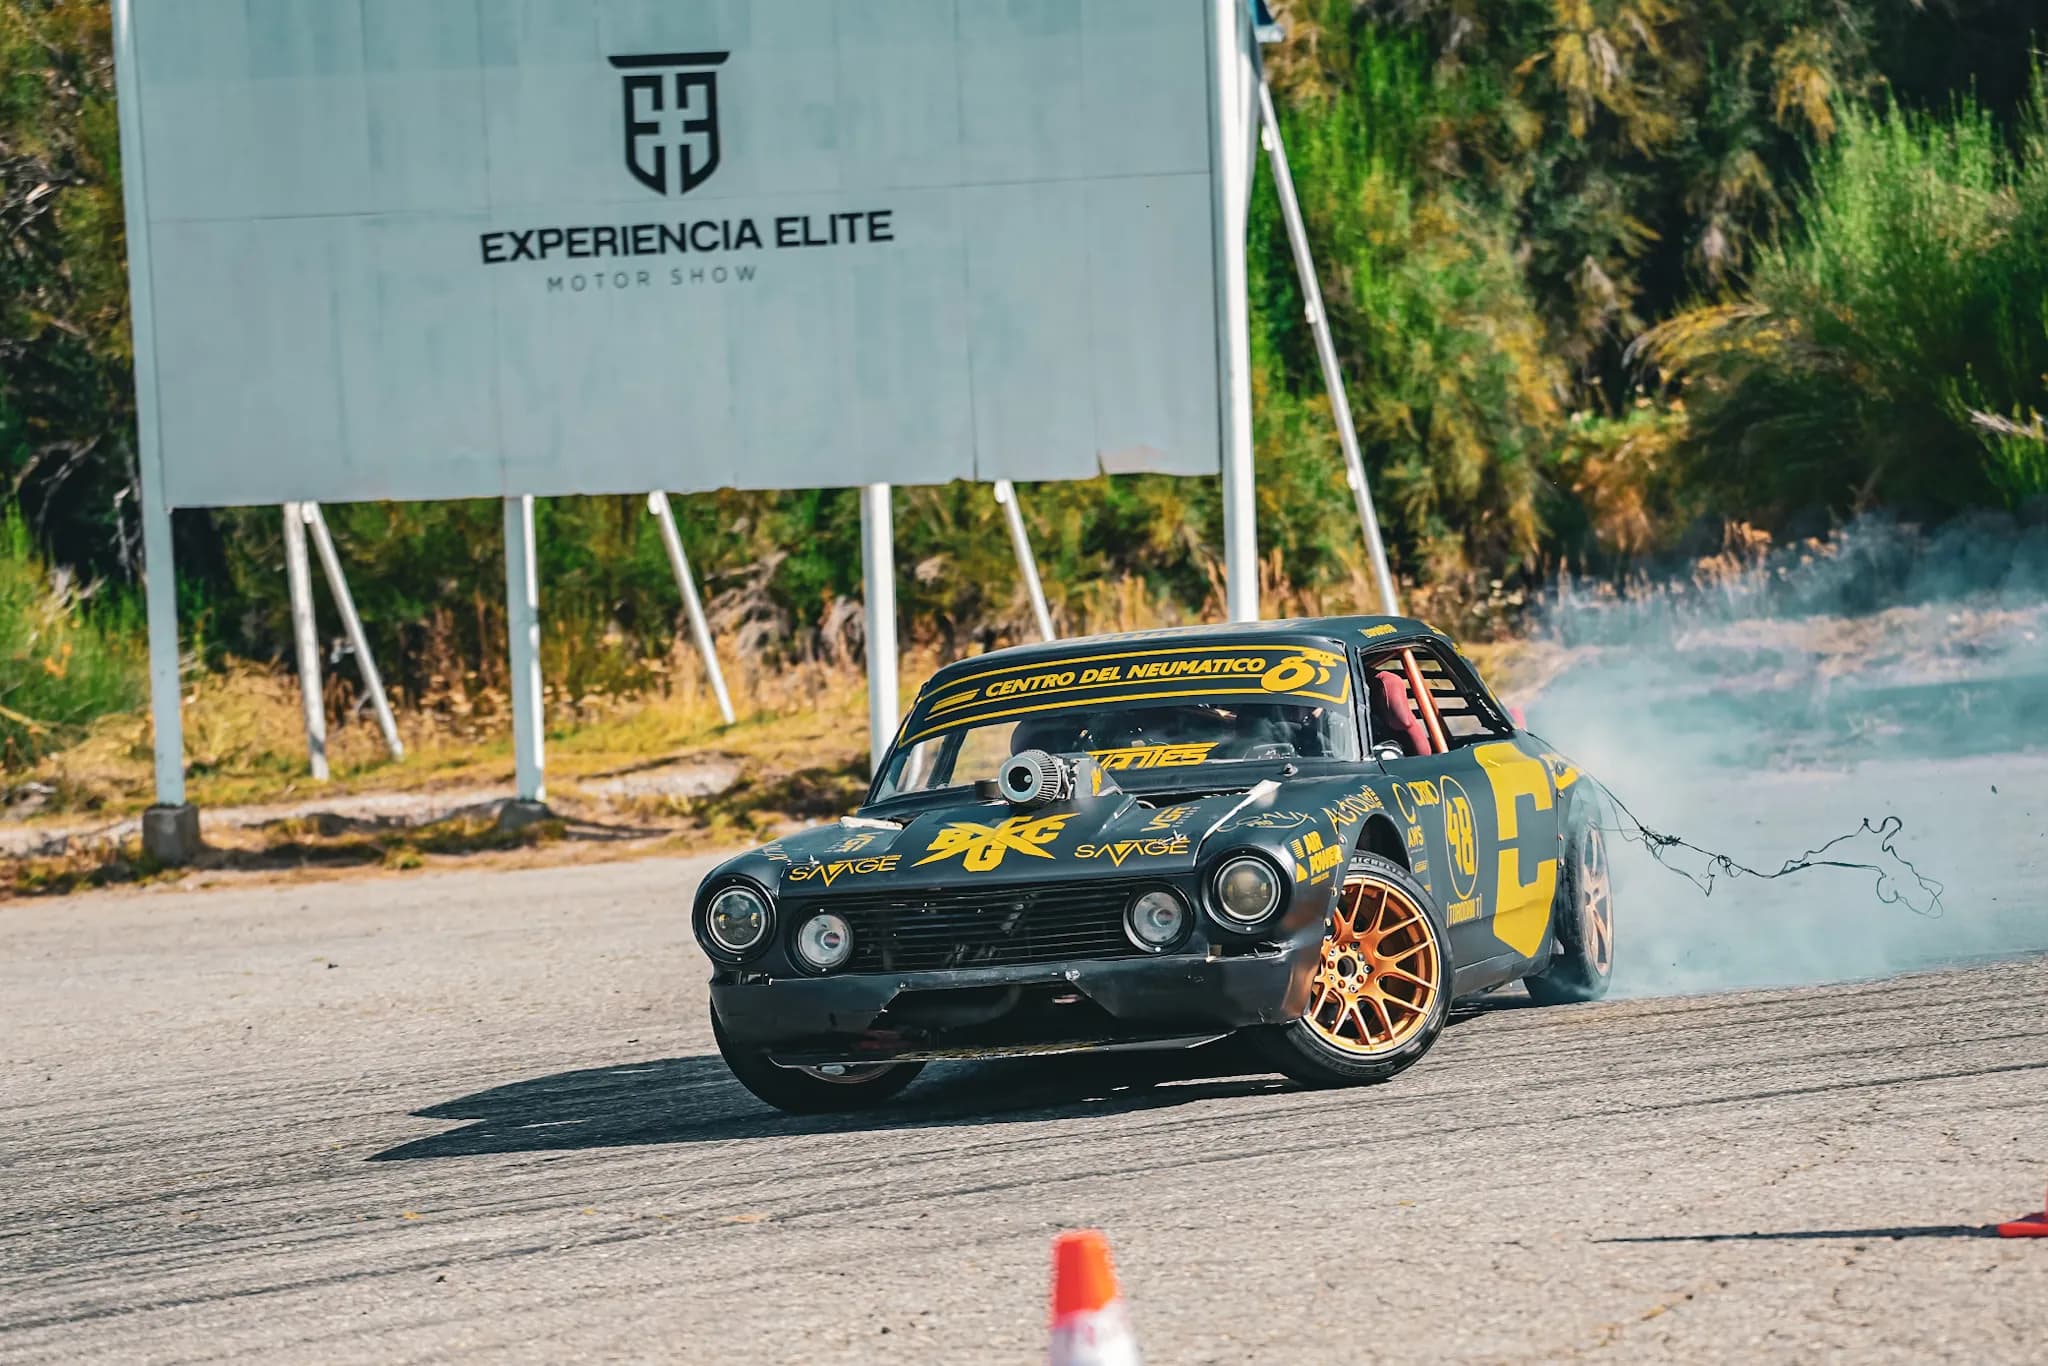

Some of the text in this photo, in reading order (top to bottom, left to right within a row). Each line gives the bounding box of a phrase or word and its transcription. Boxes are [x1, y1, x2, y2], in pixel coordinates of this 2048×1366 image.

[480, 210, 895, 265] EXPERIENCIA ELITE
[547, 264, 757, 293] MOTOR SHOW
[985, 656, 1267, 698] CENTRO DEL NEUMATICO
[1074, 837, 1191, 867] SAVAGE
[1446, 797, 1475, 875] 48
[789, 855, 903, 887] SAVAGE
[1309, 844, 1344, 876] POWER
